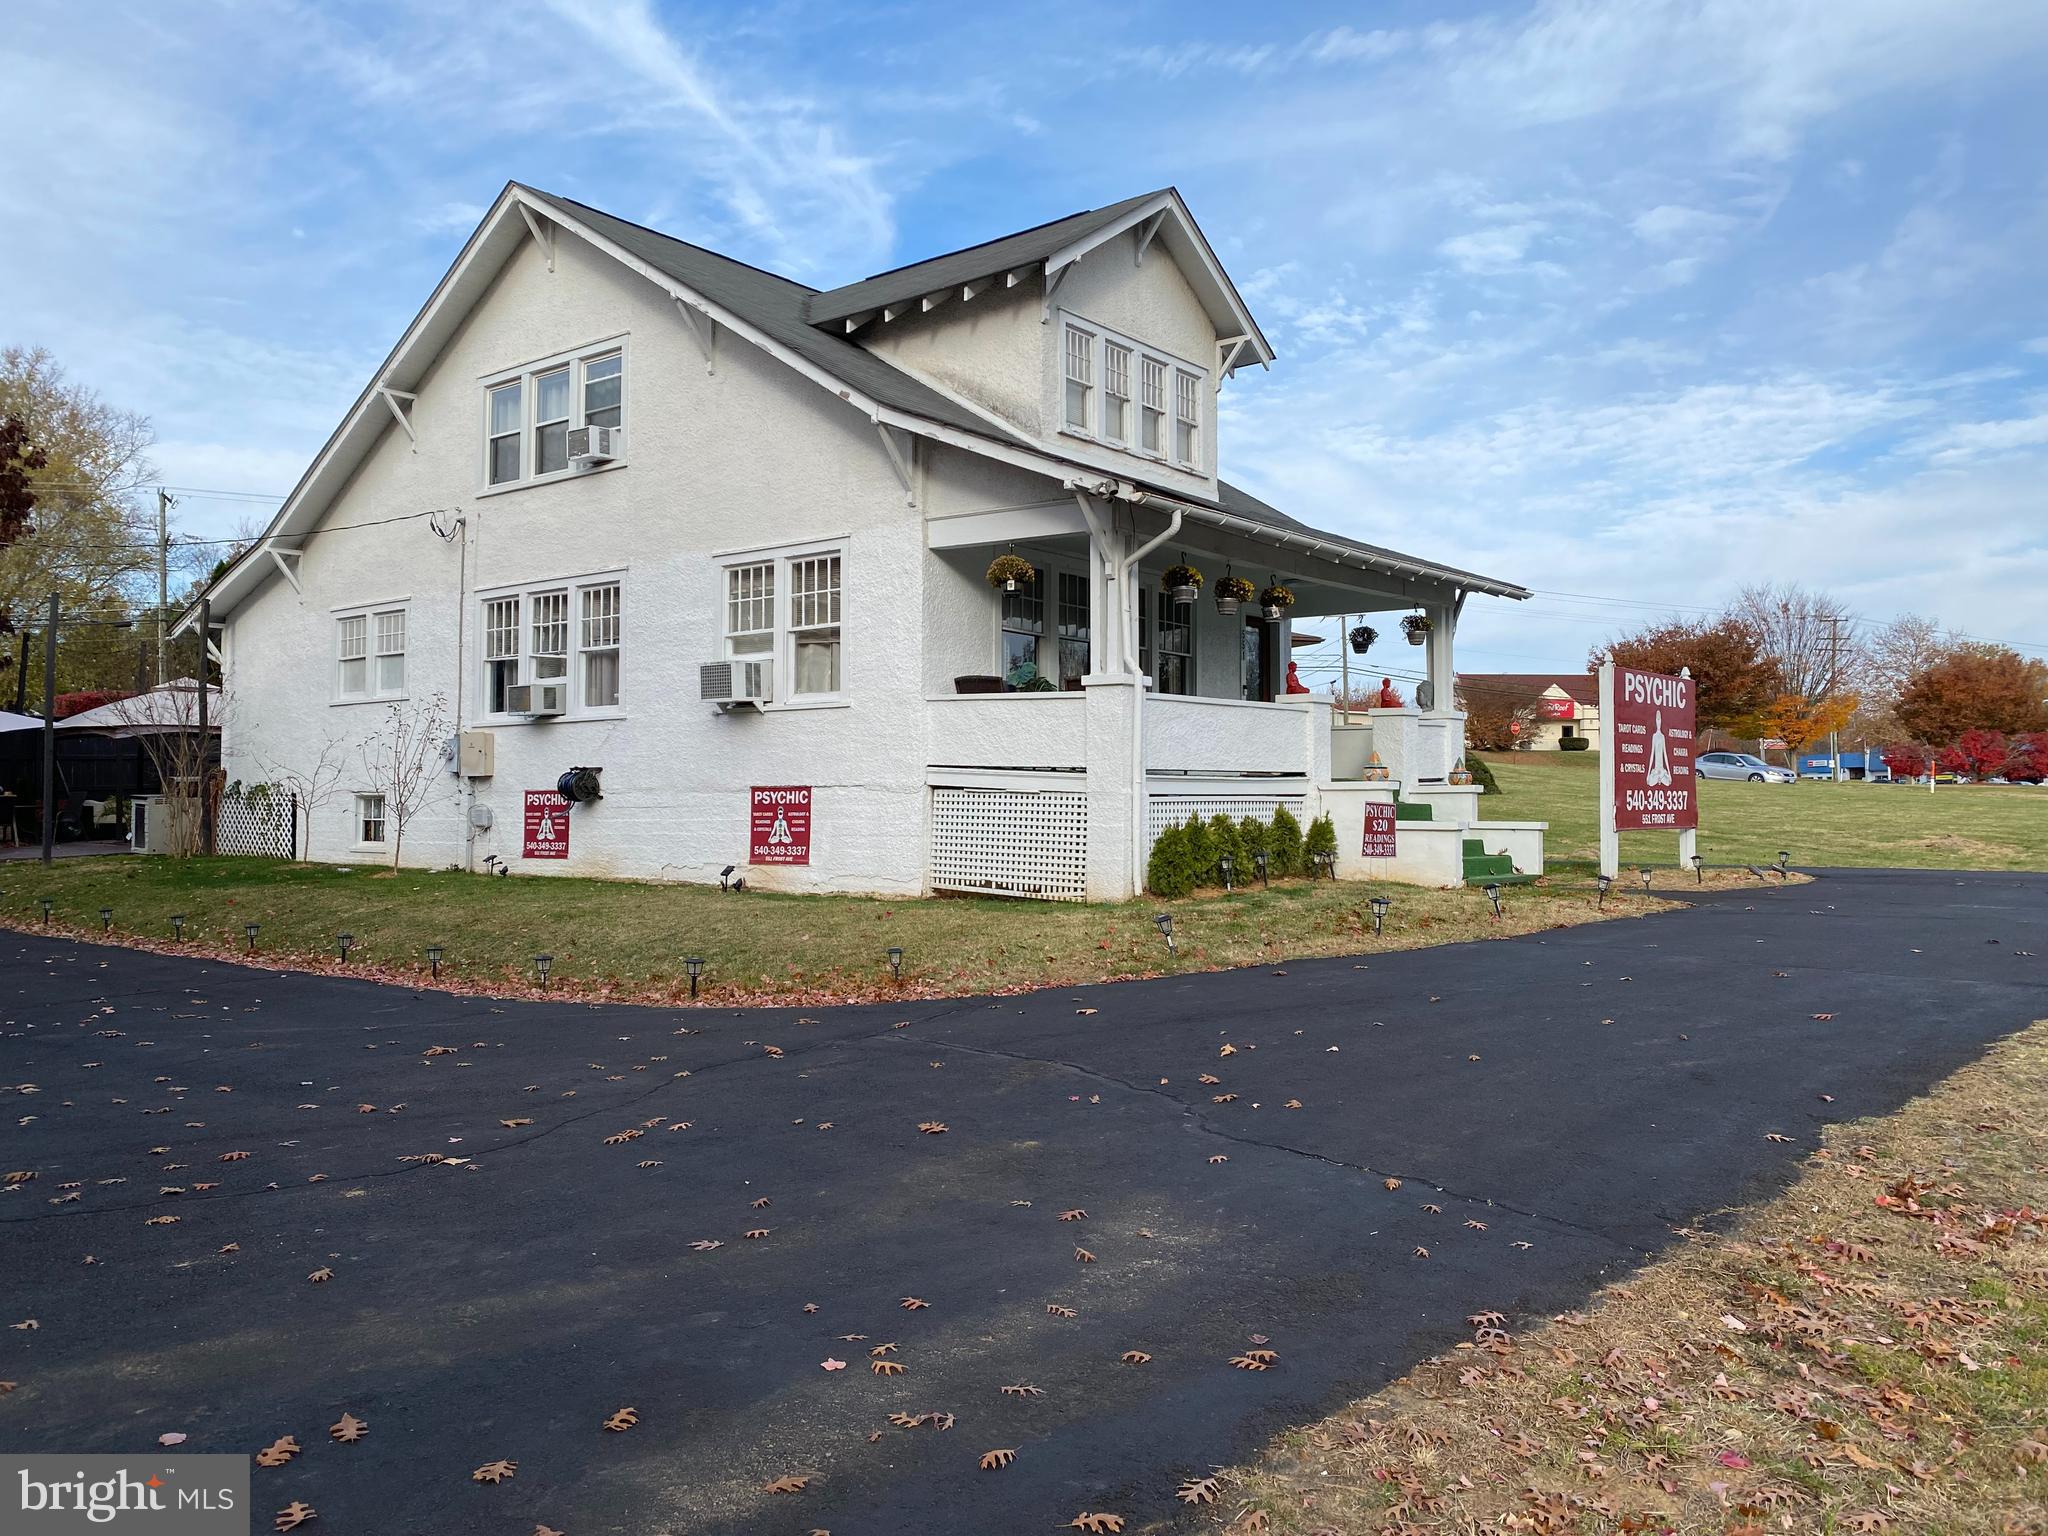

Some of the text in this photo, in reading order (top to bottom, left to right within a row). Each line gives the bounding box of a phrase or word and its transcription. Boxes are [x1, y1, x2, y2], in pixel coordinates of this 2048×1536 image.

[1625, 672, 1686, 709] PSYCHIC
[1618, 723, 1646, 735] TAROT CARDS
[1622, 743, 1643, 754] READINGS
[1625, 763, 1645, 773] CRYSTALS
[1673, 765, 1689, 775] READING
[527, 794, 568, 806] PSYCHIC
[754, 790, 809, 805] PSYCHIC
[1626, 789, 1688, 811] 540-349-3337
[1366, 804, 1395, 819] PSYCHIC
[1651, 814, 1666, 824] FROST
[1666, 814, 1675, 824] AVE
[1372, 819, 1388, 832] $20
[1364, 833, 1395, 843] READINGS
[526, 841, 567, 850] 540-349-3337
[754, 845, 806, 855] 540-349-3337
